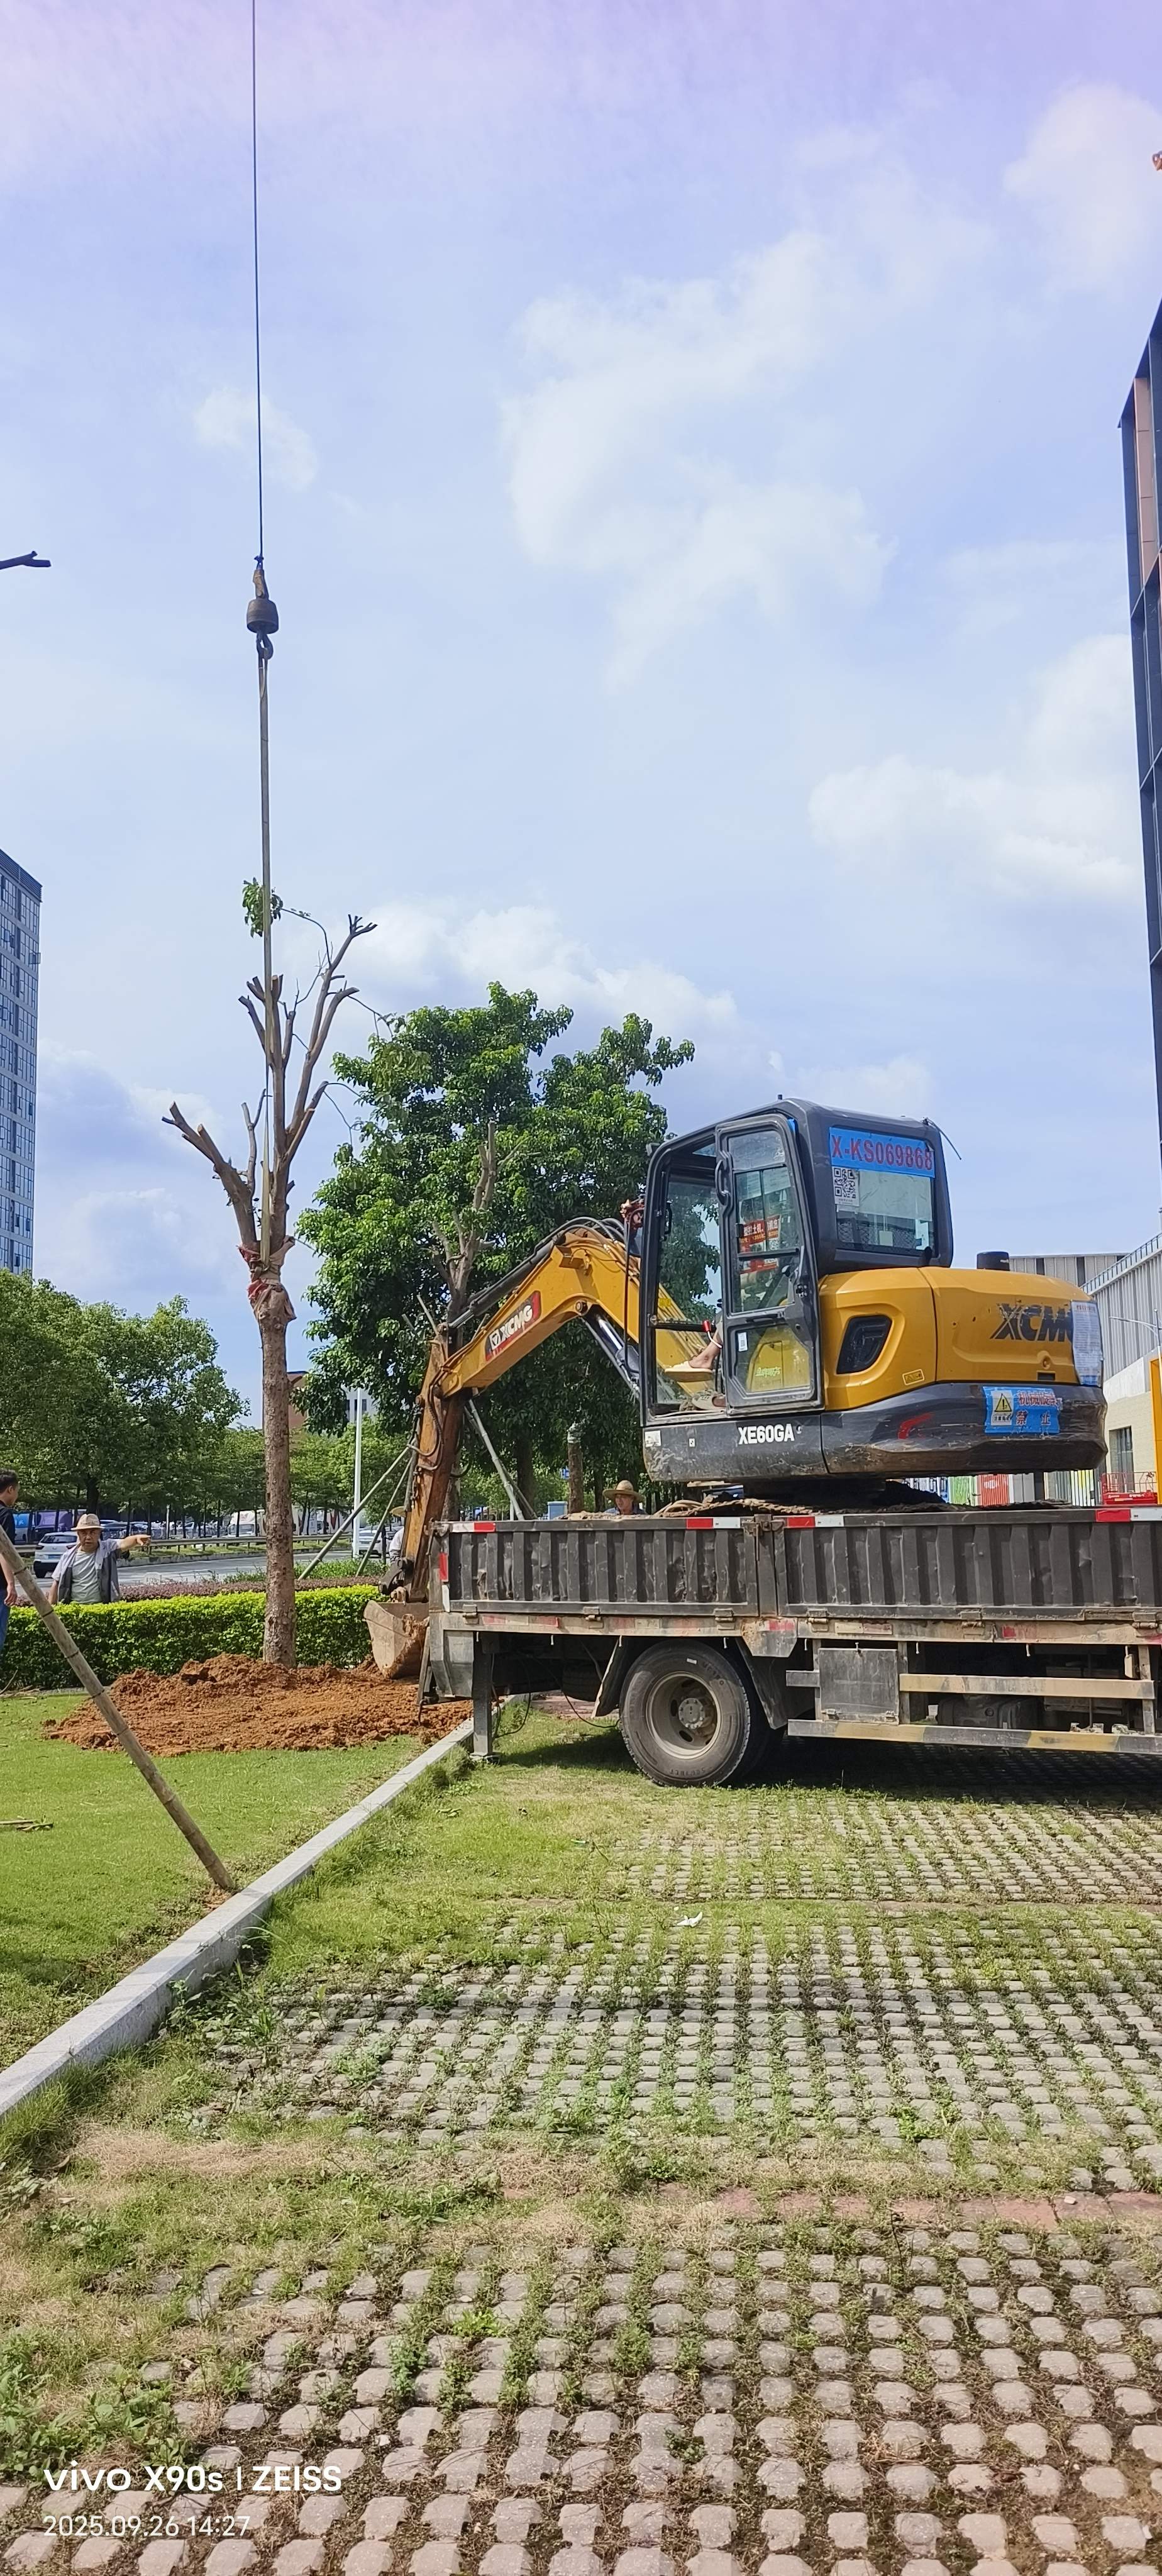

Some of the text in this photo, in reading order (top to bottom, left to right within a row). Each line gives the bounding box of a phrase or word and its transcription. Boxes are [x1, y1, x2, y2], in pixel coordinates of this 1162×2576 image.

[831, 1135, 933, 1171] X-KS069868
[500, 1305, 533, 1341] XCMG
[989, 1302, 1073, 1342] XCM
[738, 1423, 795, 1445] XE60GA
